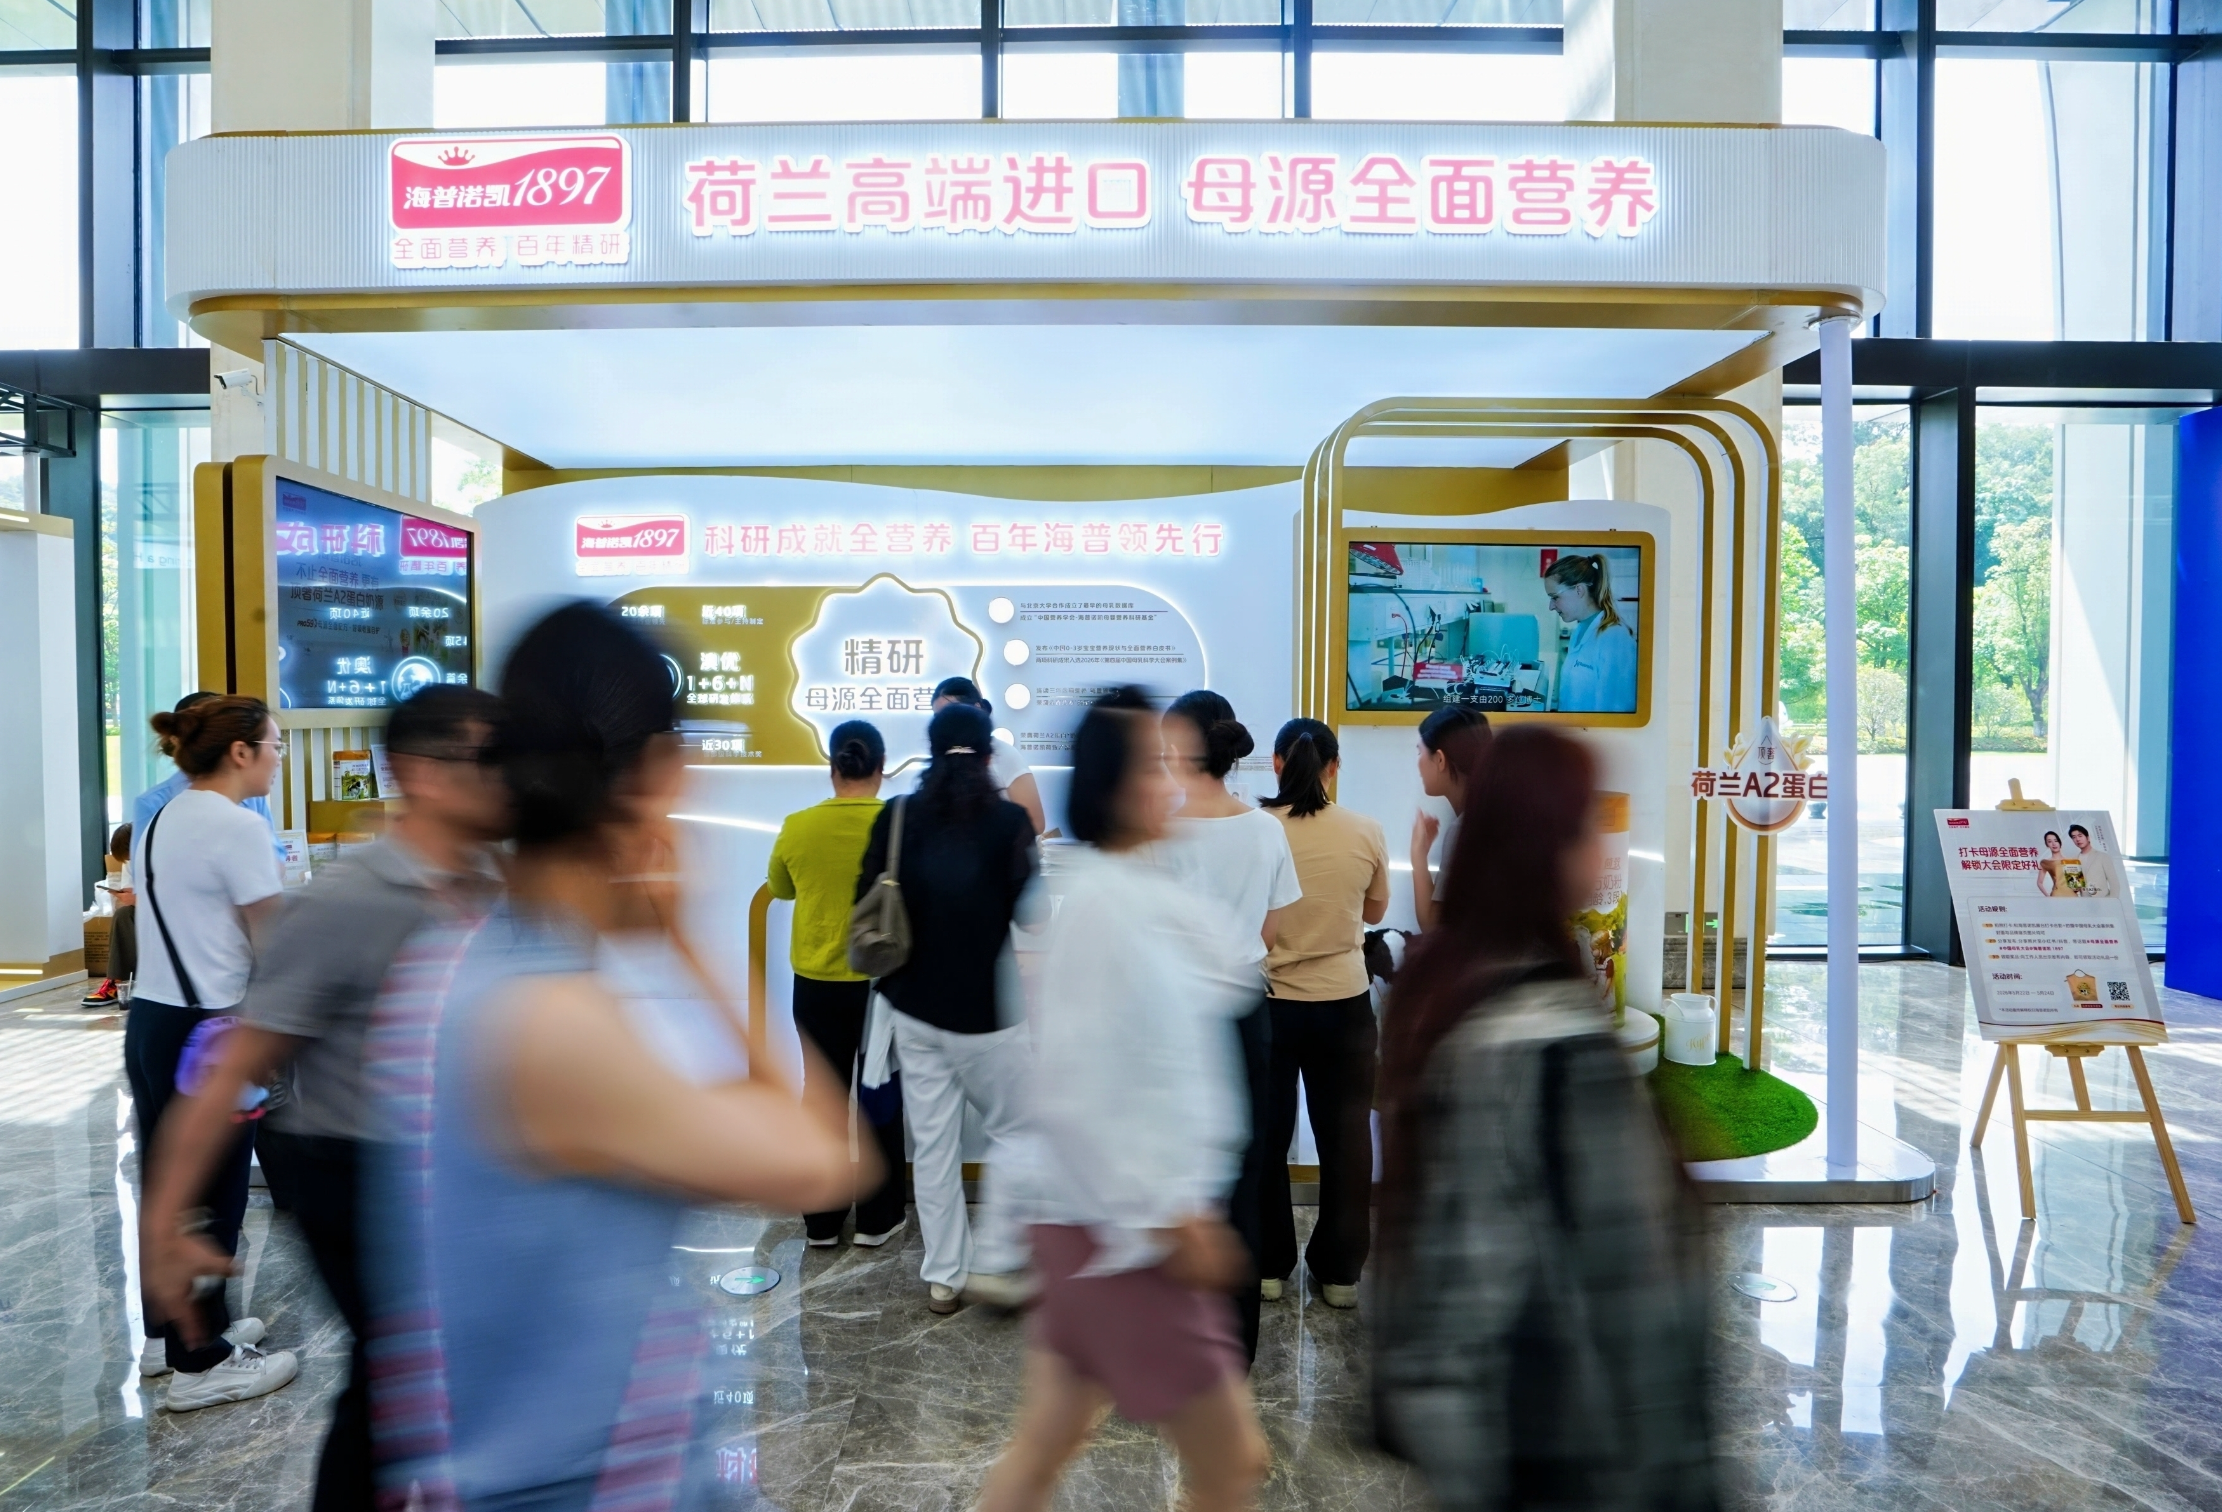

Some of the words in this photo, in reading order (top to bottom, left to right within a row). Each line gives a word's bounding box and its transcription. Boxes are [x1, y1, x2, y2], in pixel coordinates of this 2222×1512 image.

[687, 155, 1148, 229] 荷兰高端进口
[1187, 155, 1656, 229] 母源全面营养
[394, 234, 497, 261] 全面营养
[516, 231, 623, 258] 百年精研
[704, 523, 953, 555] 科研成就全营养
[971, 522, 1224, 555] 百年海普领先行
[702, 604, 747, 618] 近40项
[844, 638, 923, 676] 精研
[1443, 694, 1503, 704] 组建一支由200
[702, 738, 746, 752] 近30项
[1691, 771, 1828, 800] 荷兰A2蛋白
[1958, 846, 2039, 858] 打卡母源全面营养
[1961, 859, 2042, 871] 解锁大会限定好礼
